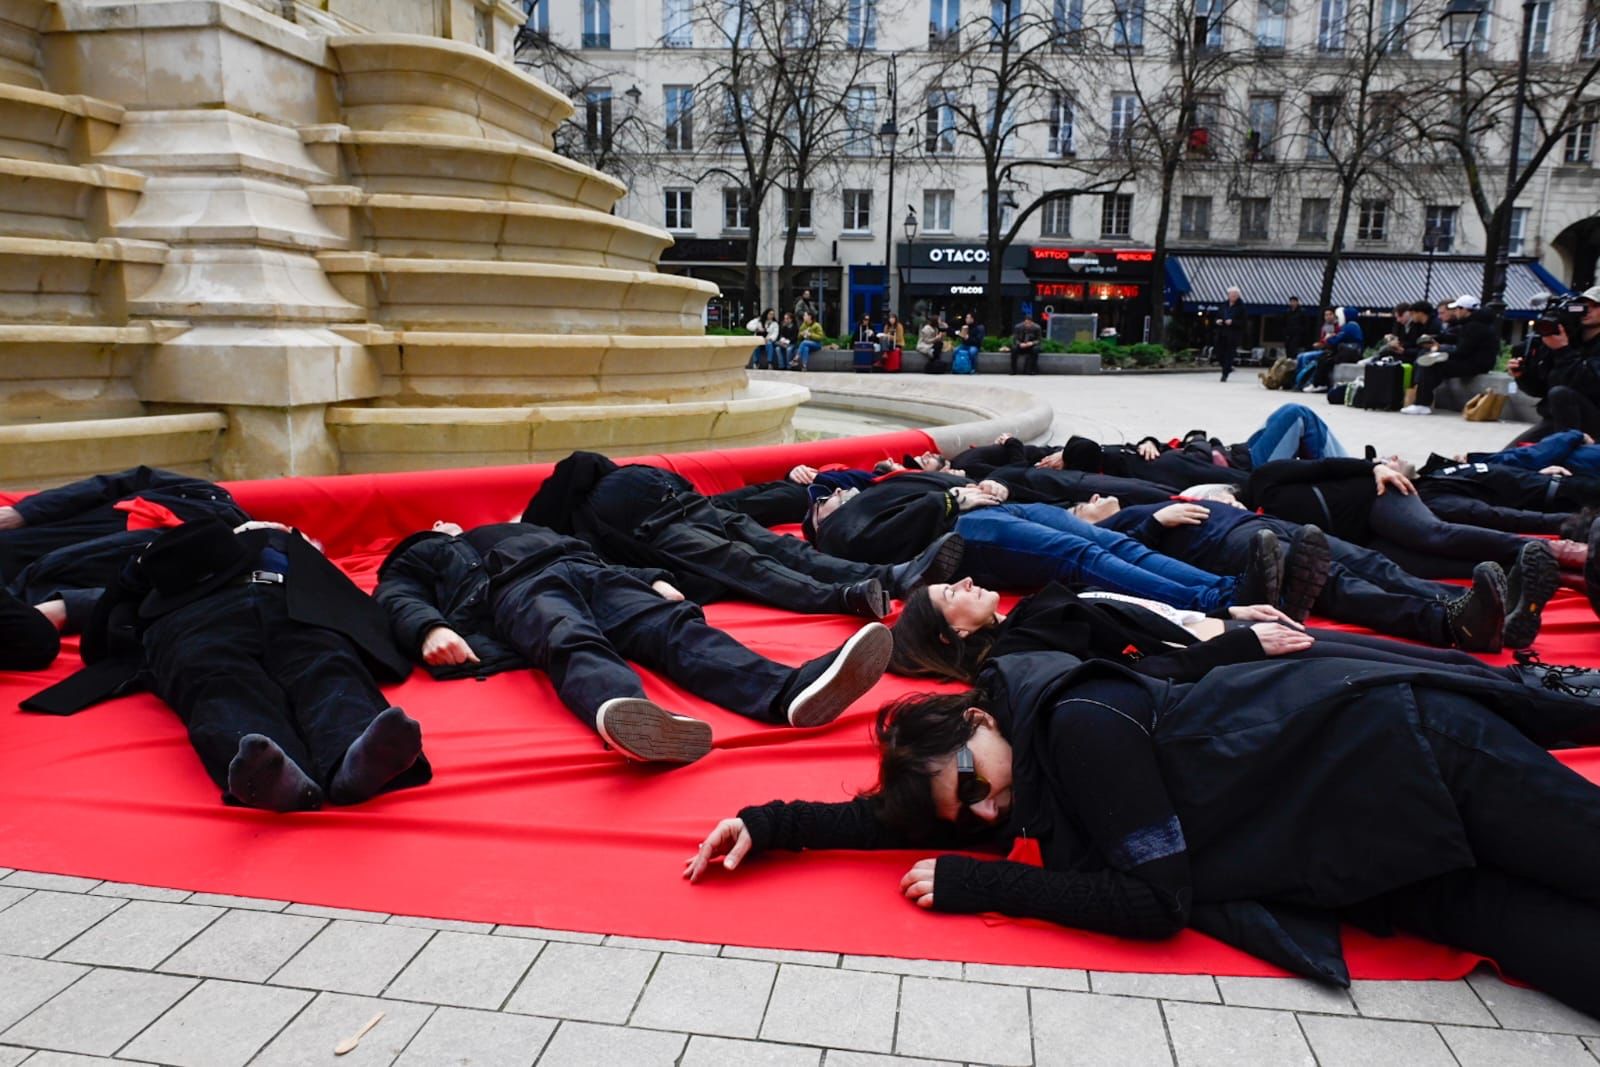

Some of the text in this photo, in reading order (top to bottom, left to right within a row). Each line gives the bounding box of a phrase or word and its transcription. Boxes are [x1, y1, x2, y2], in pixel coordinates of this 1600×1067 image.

[929, 248, 990, 262] O'TACO
[1034, 251, 1068, 259] TATTOO
[1116, 253, 1152, 261] PIERCING
[950, 286, 983, 294] O'TACOS
[1036, 284, 1083, 297] TATTOO
